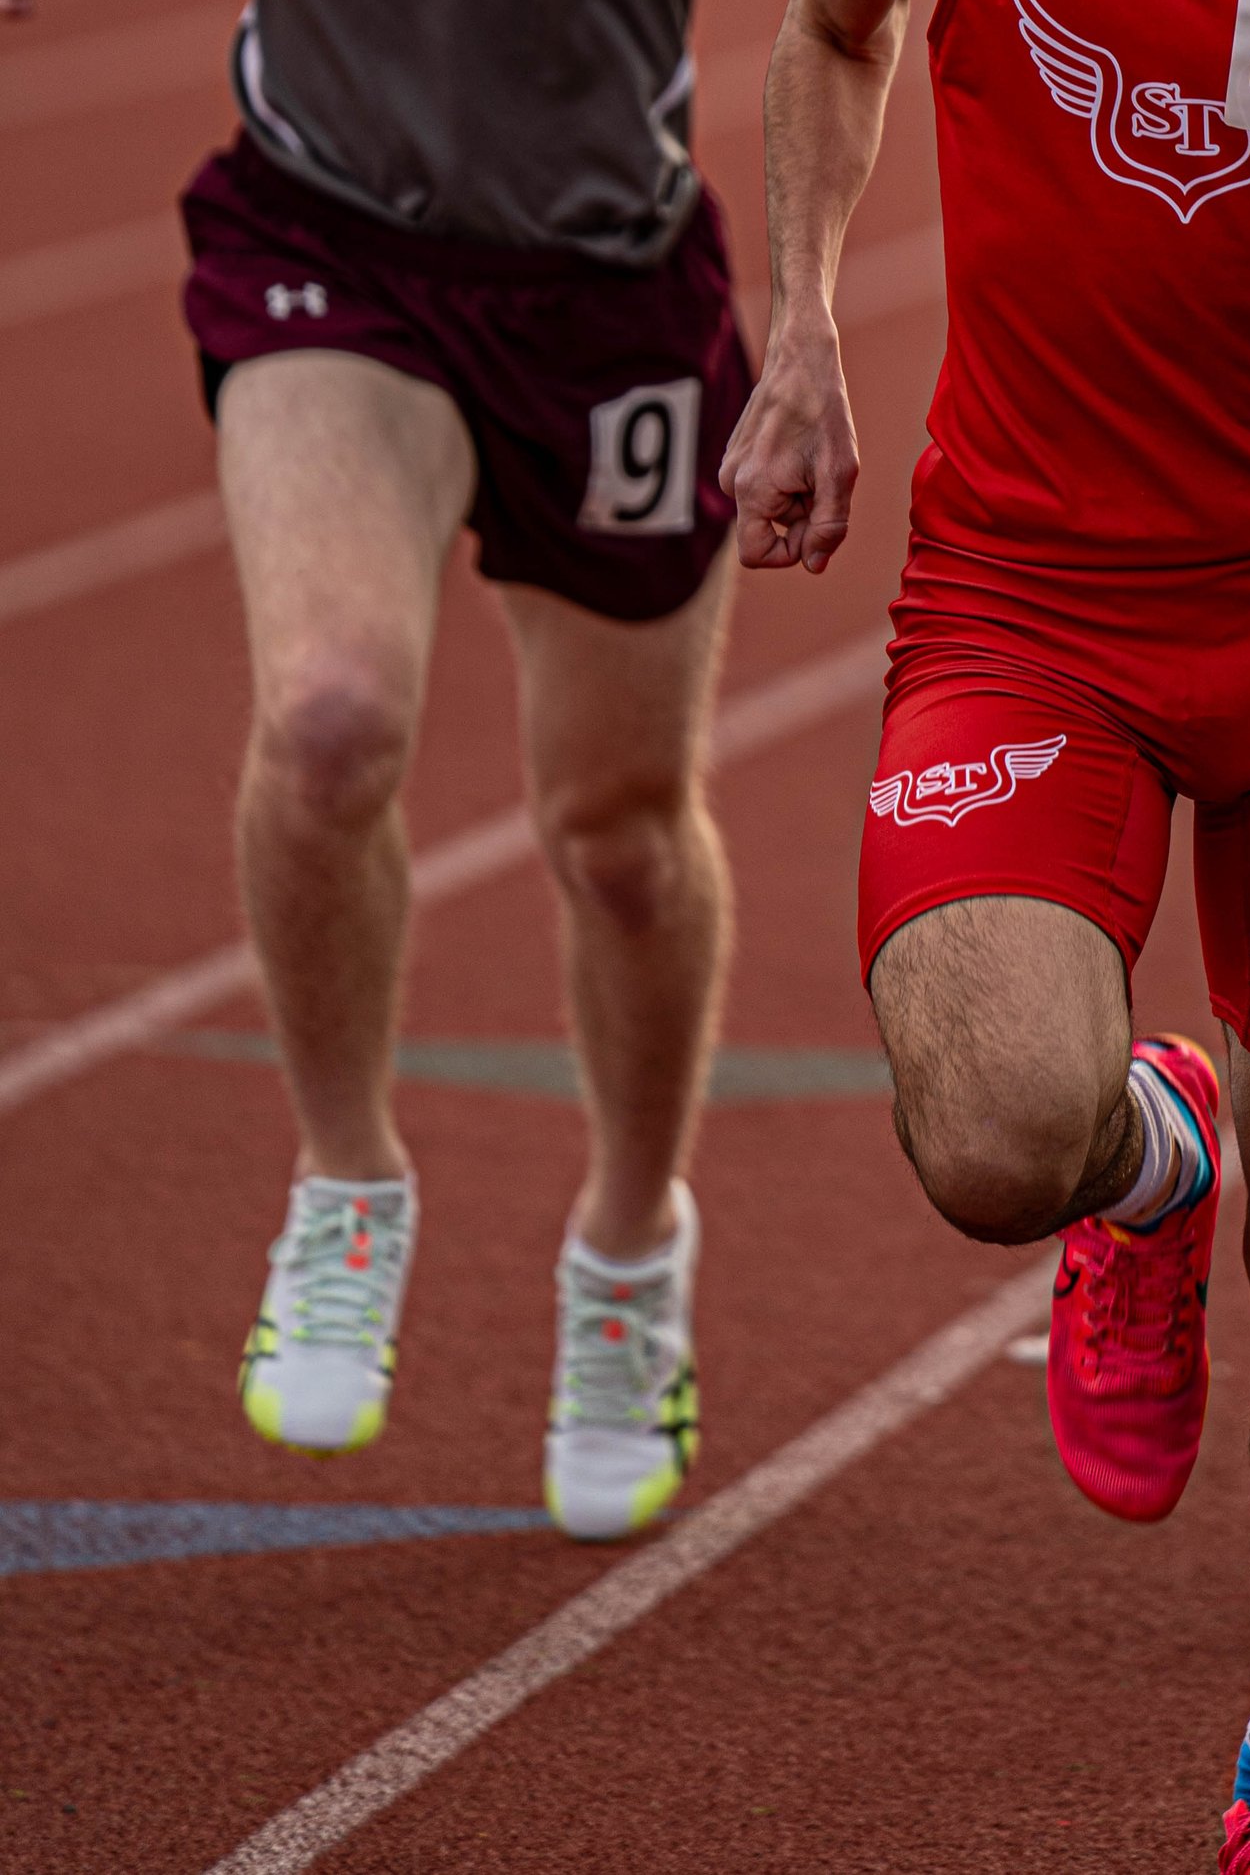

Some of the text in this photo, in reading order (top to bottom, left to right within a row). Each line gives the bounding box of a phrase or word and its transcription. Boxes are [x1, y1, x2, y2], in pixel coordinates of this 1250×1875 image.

[1131, 82, 1227, 156] ST
[614, 400, 671, 522] 9
[915, 761, 988, 801] ST
